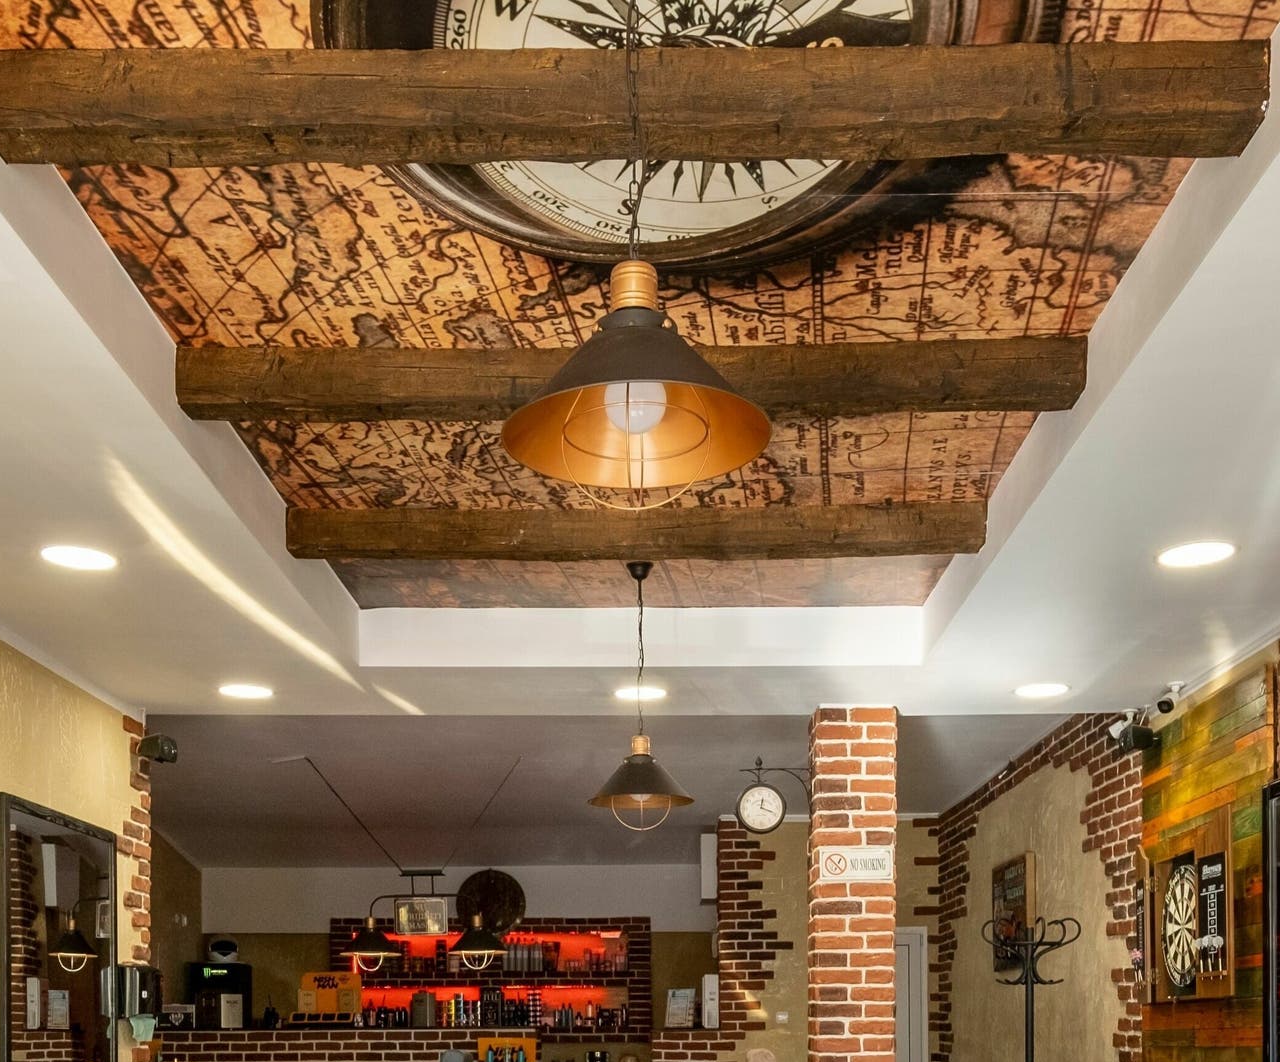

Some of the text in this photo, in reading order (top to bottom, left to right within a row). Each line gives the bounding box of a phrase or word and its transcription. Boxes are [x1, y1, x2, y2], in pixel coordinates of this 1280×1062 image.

[450, 9, 468, 50] 260
[532, 189, 570, 212] 200
[850, 857, 886, 871] NO SMOKING
